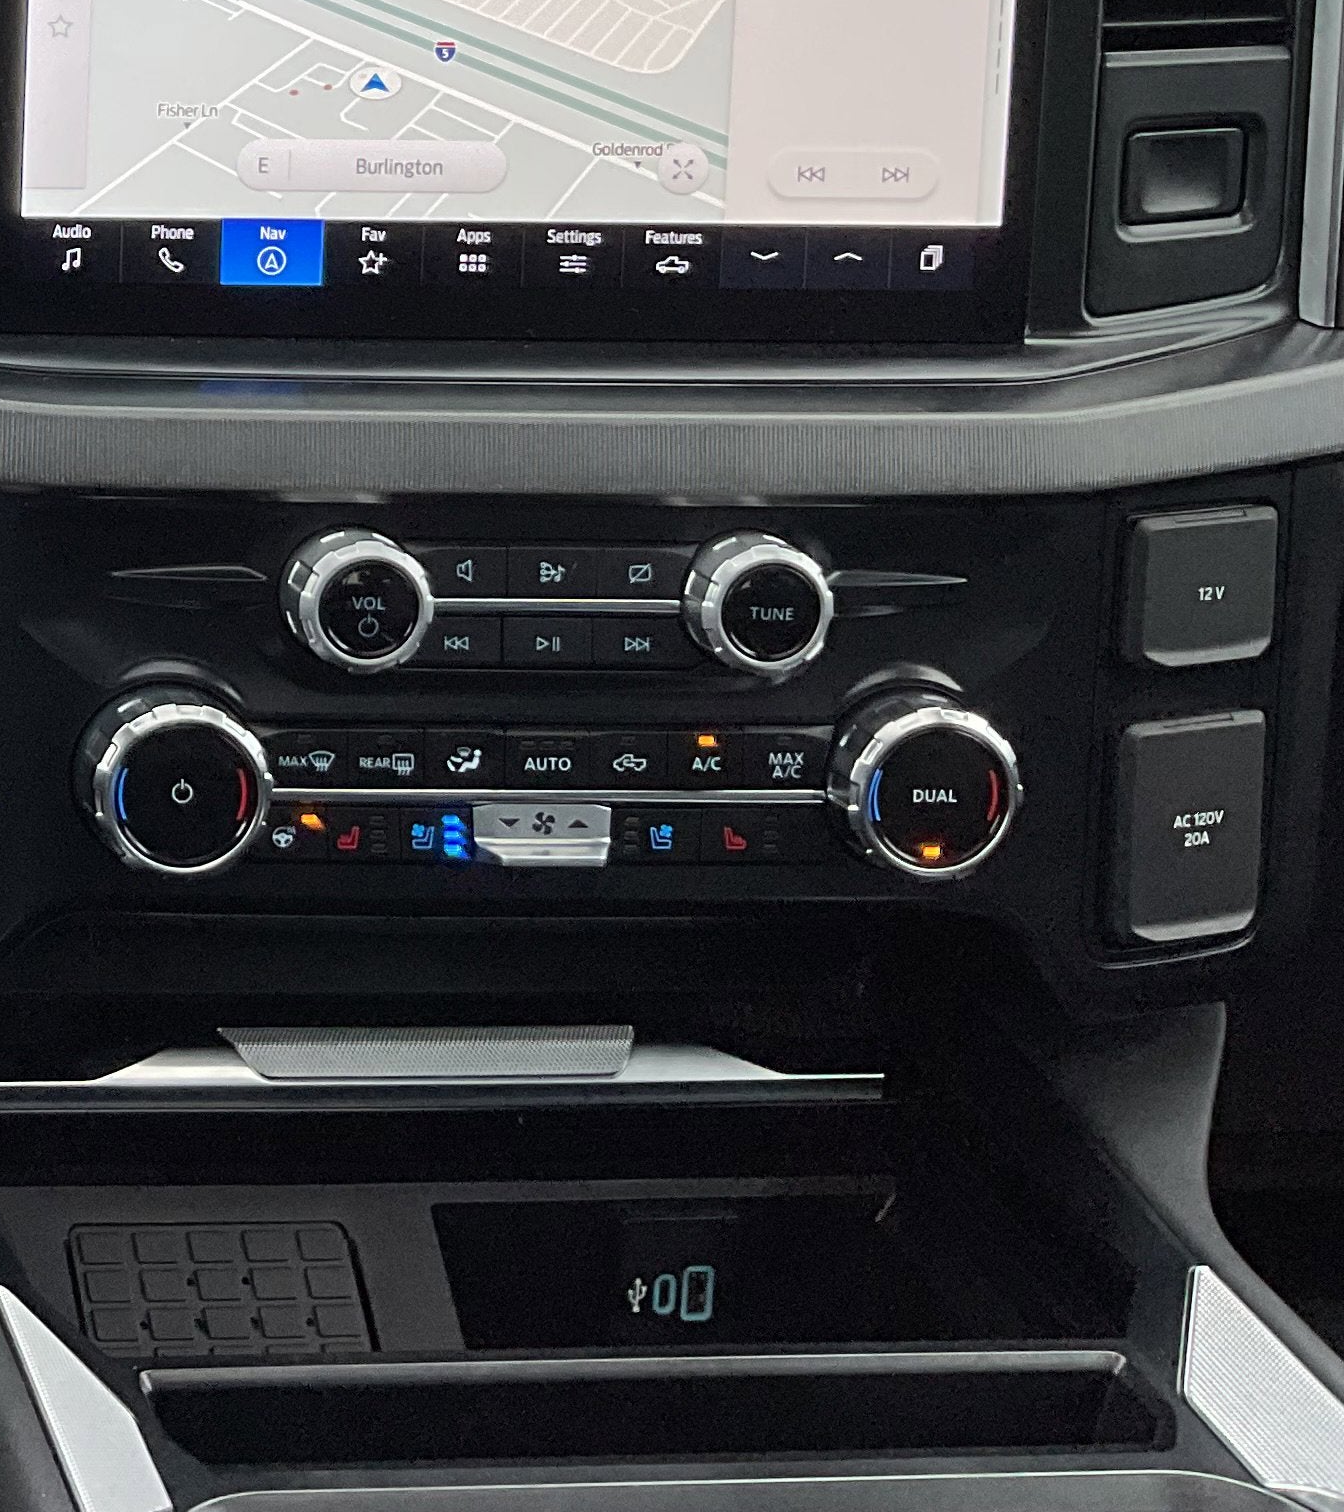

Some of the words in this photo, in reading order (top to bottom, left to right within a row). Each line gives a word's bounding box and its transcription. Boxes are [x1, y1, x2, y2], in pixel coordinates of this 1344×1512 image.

[440, 48, 450, 60] 5
[157, 103, 198, 118] Fisher
[201, 103, 219, 118] Ln
[592, 141, 663, 157] Goldenrod
[257, 157, 269, 173] E
[356, 157, 443, 180] Burlington
[52, 223, 91, 240] Audio
[150, 223, 194, 240] Phone
[259, 225, 286, 241] Nav
[361, 226, 386, 242] Fav
[456, 228, 491, 246] Apps
[546, 228, 602, 247] Settings
[645, 229, 703, 245] Features
[352, 595, 386, 612] VOL
[749, 606, 794, 621] TUNE
[278, 755, 308, 768] MAX
[359, 756, 391, 769] REAR
[524, 755, 572, 772] AUTO
[691, 756, 722, 772] A/C
[768, 751, 804, 766] MAX
[772, 763, 802, 780] A/C
[912, 788, 957, 804] DUAL
[1173, 814, 1192, 829] AC
[1193, 810, 1225, 827] 120V
[1184, 832, 1210, 848] 20A
